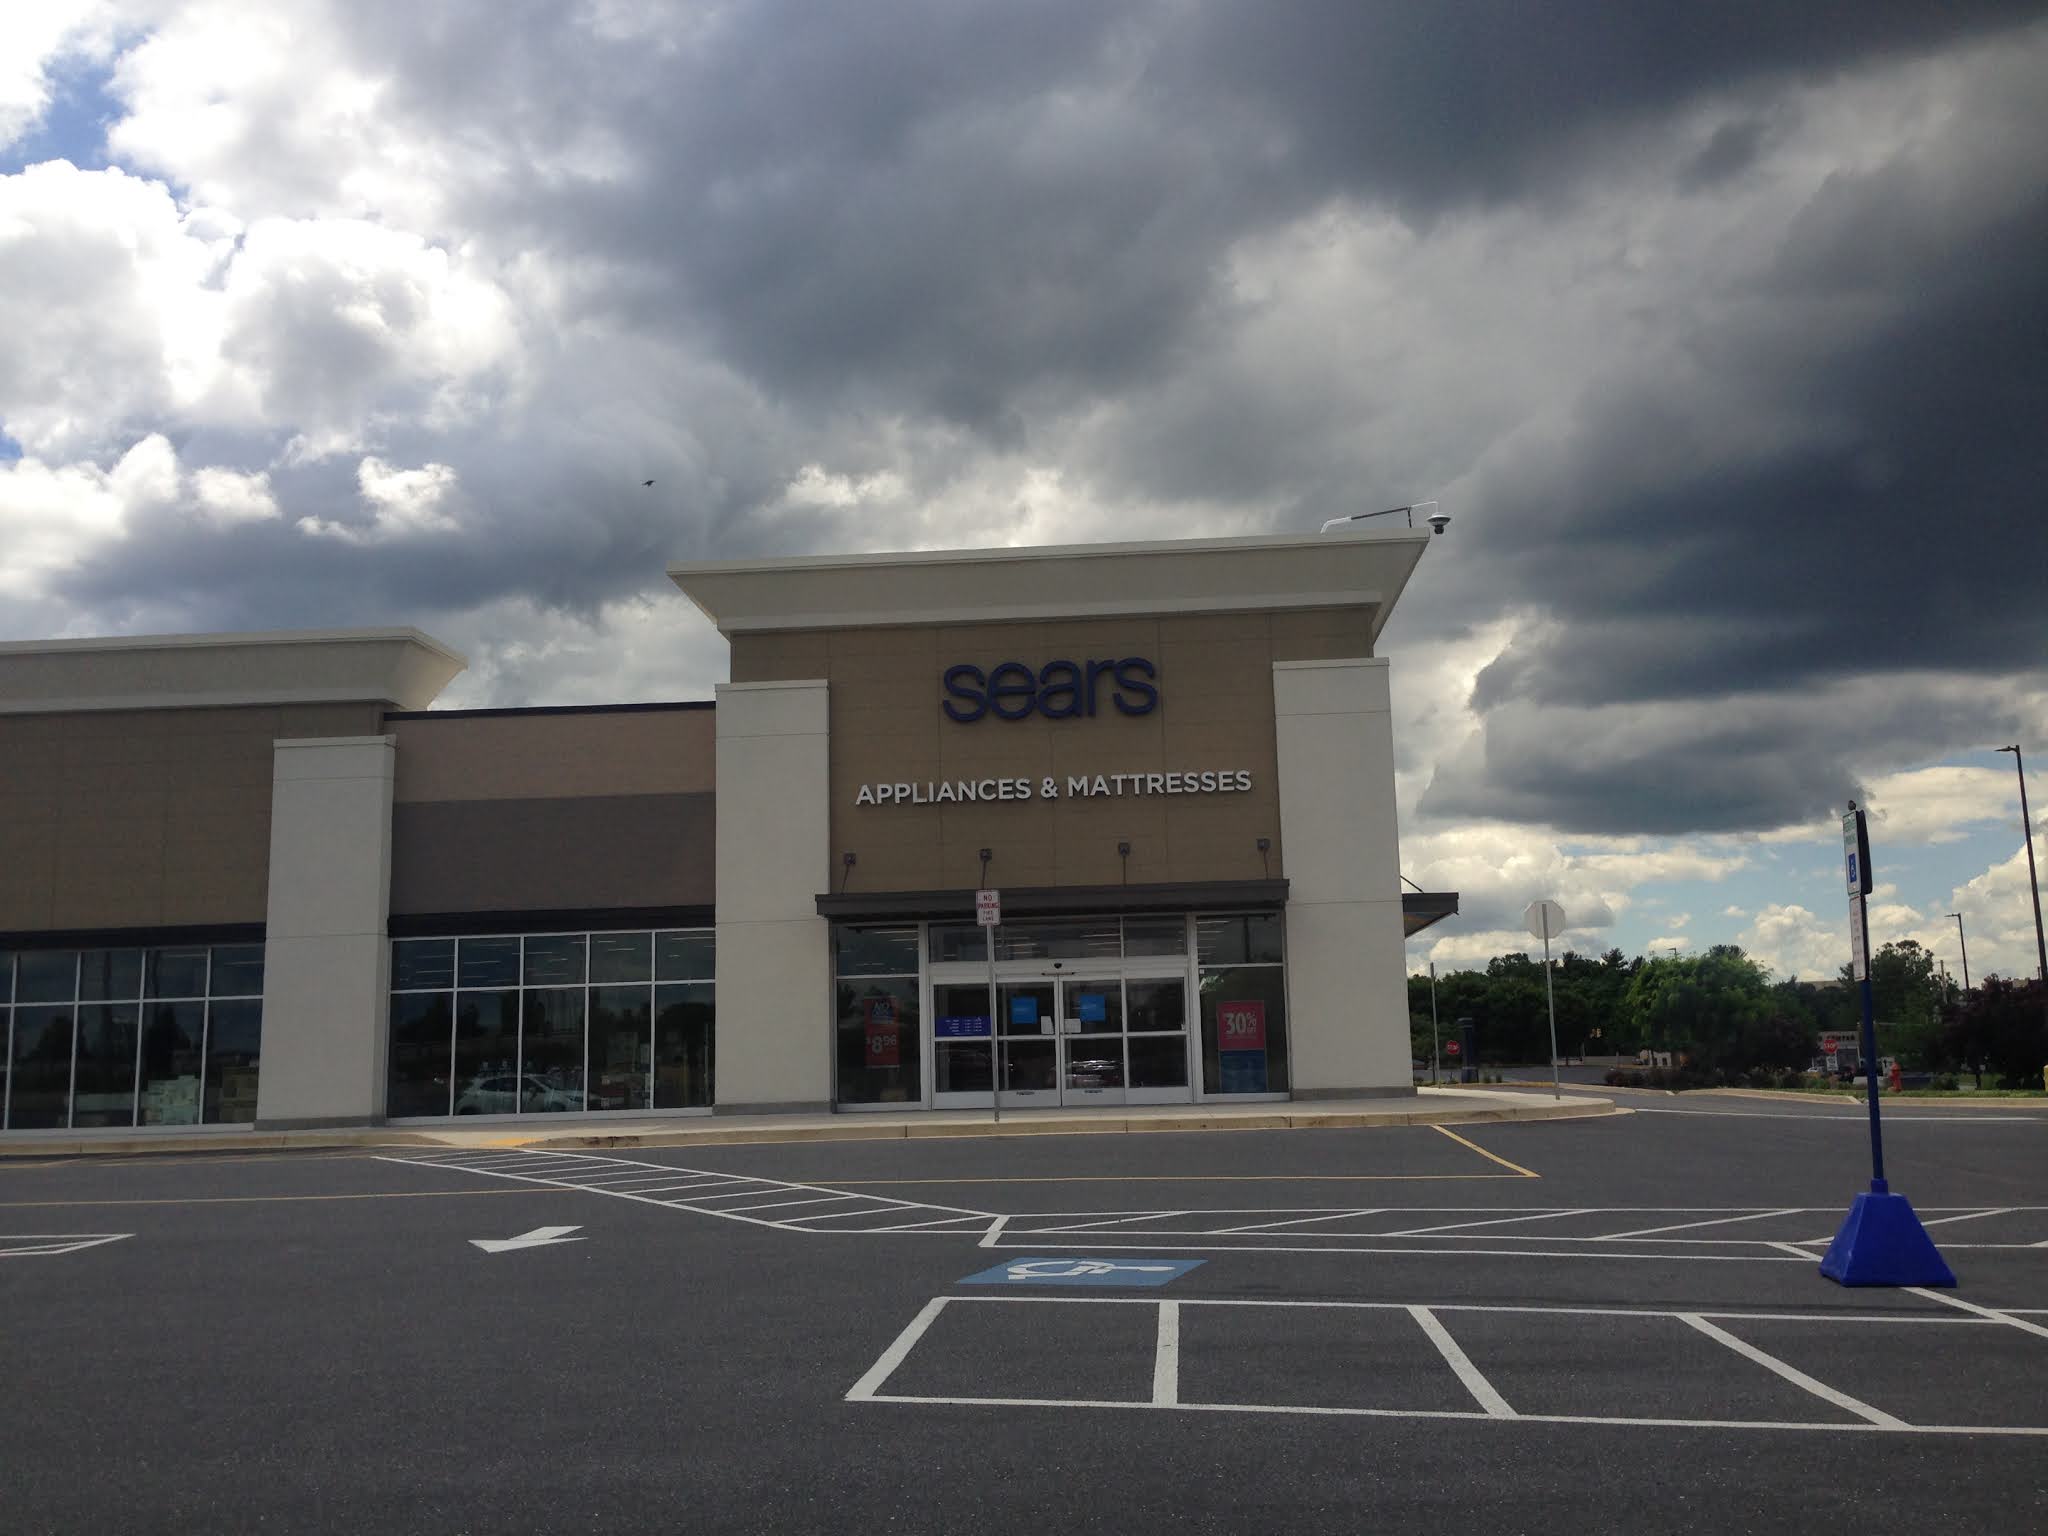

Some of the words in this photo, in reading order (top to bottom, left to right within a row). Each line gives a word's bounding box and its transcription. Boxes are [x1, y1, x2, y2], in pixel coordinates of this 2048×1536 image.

[943, 657, 1158, 723] sears
[855, 778, 1032, 806] APPLIANCES
[1040, 776, 1058, 799] &
[1067, 770, 1252, 799] MATTRESSES
